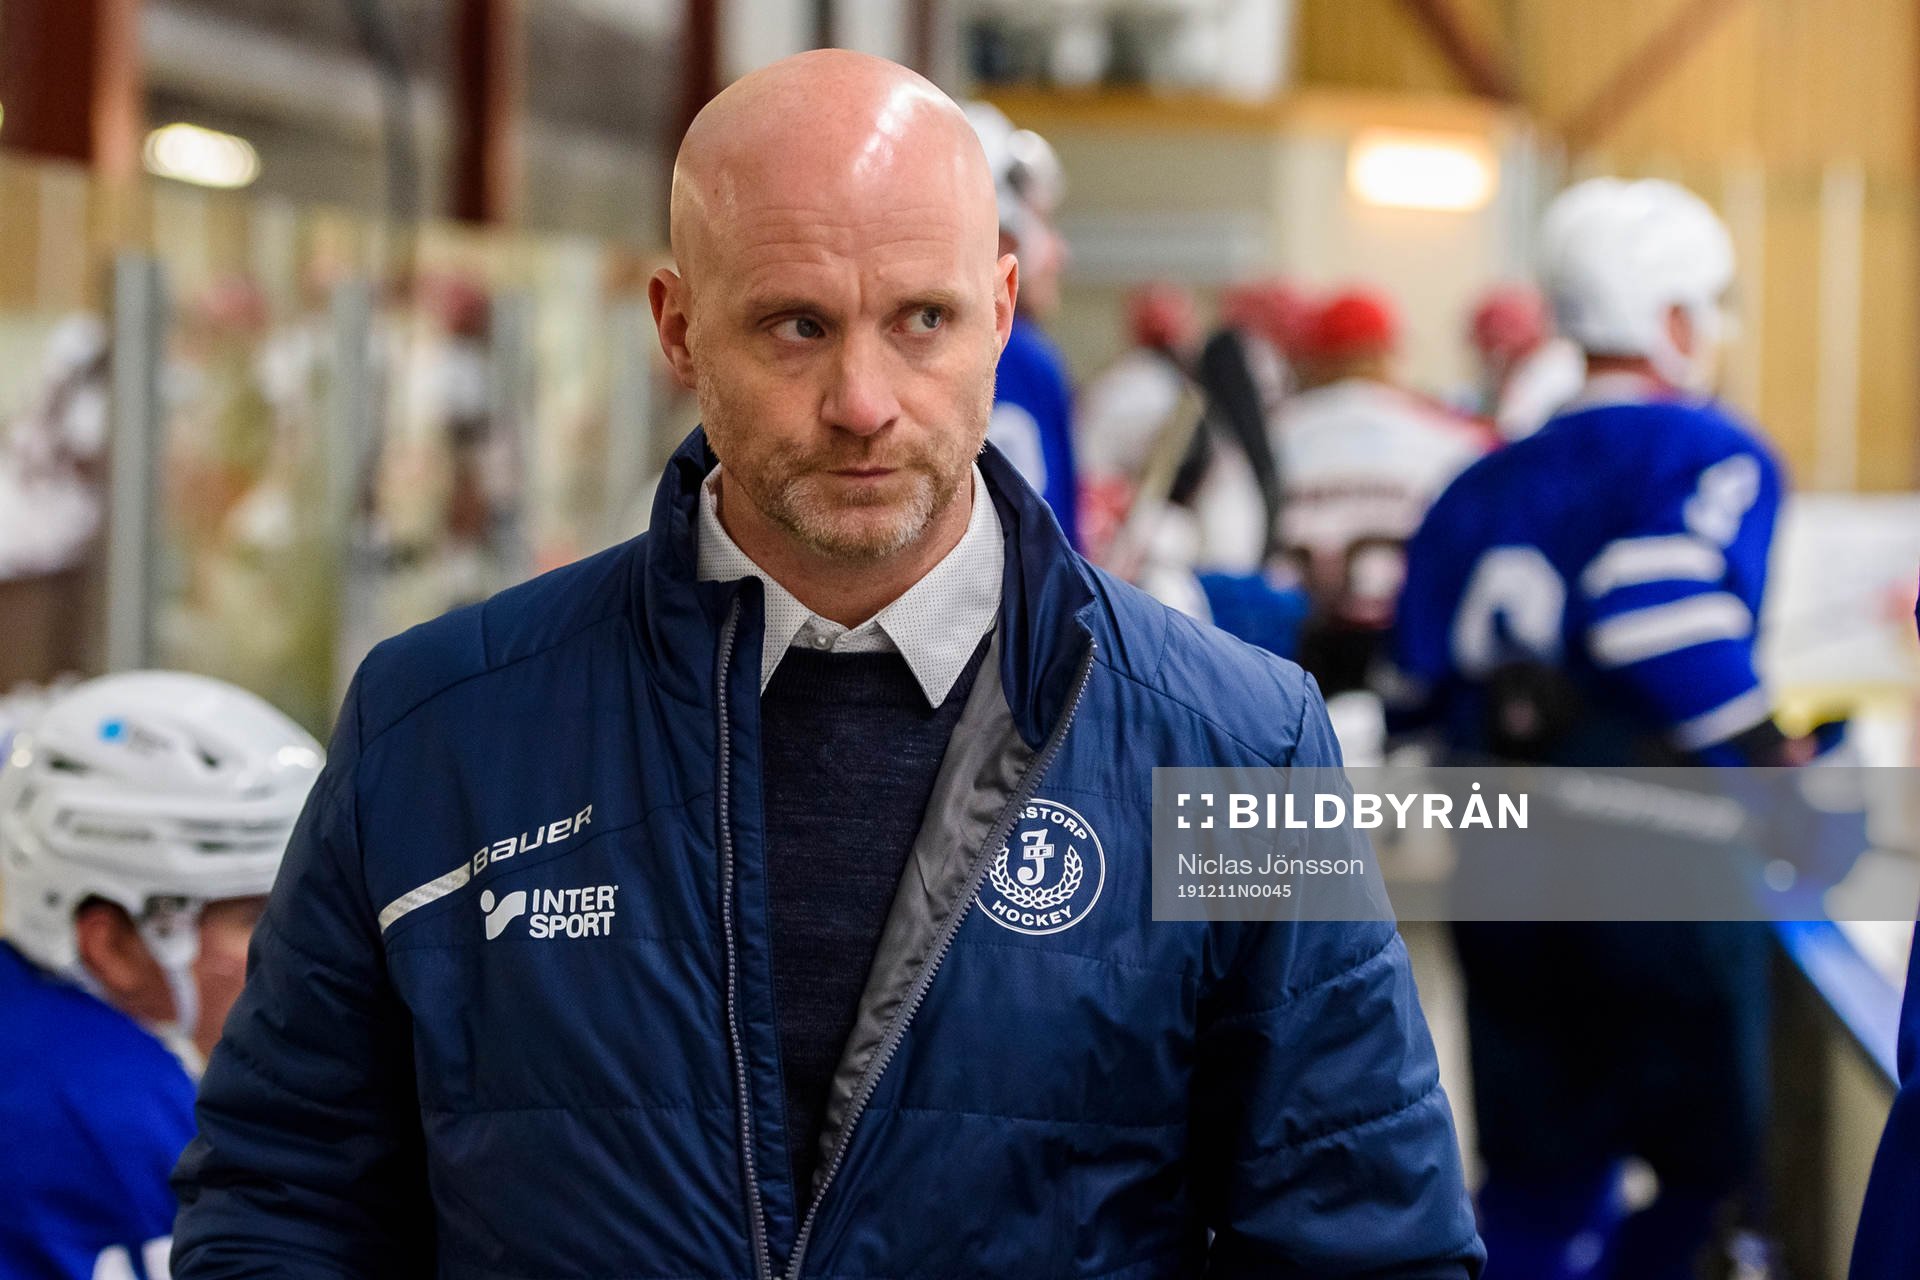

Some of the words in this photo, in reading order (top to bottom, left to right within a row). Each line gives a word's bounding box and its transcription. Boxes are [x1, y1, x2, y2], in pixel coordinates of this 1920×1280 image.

[532, 885, 615, 914] INTER
[992, 900, 1072, 927] HOCKEY
[529, 911, 615, 939] SPORT
